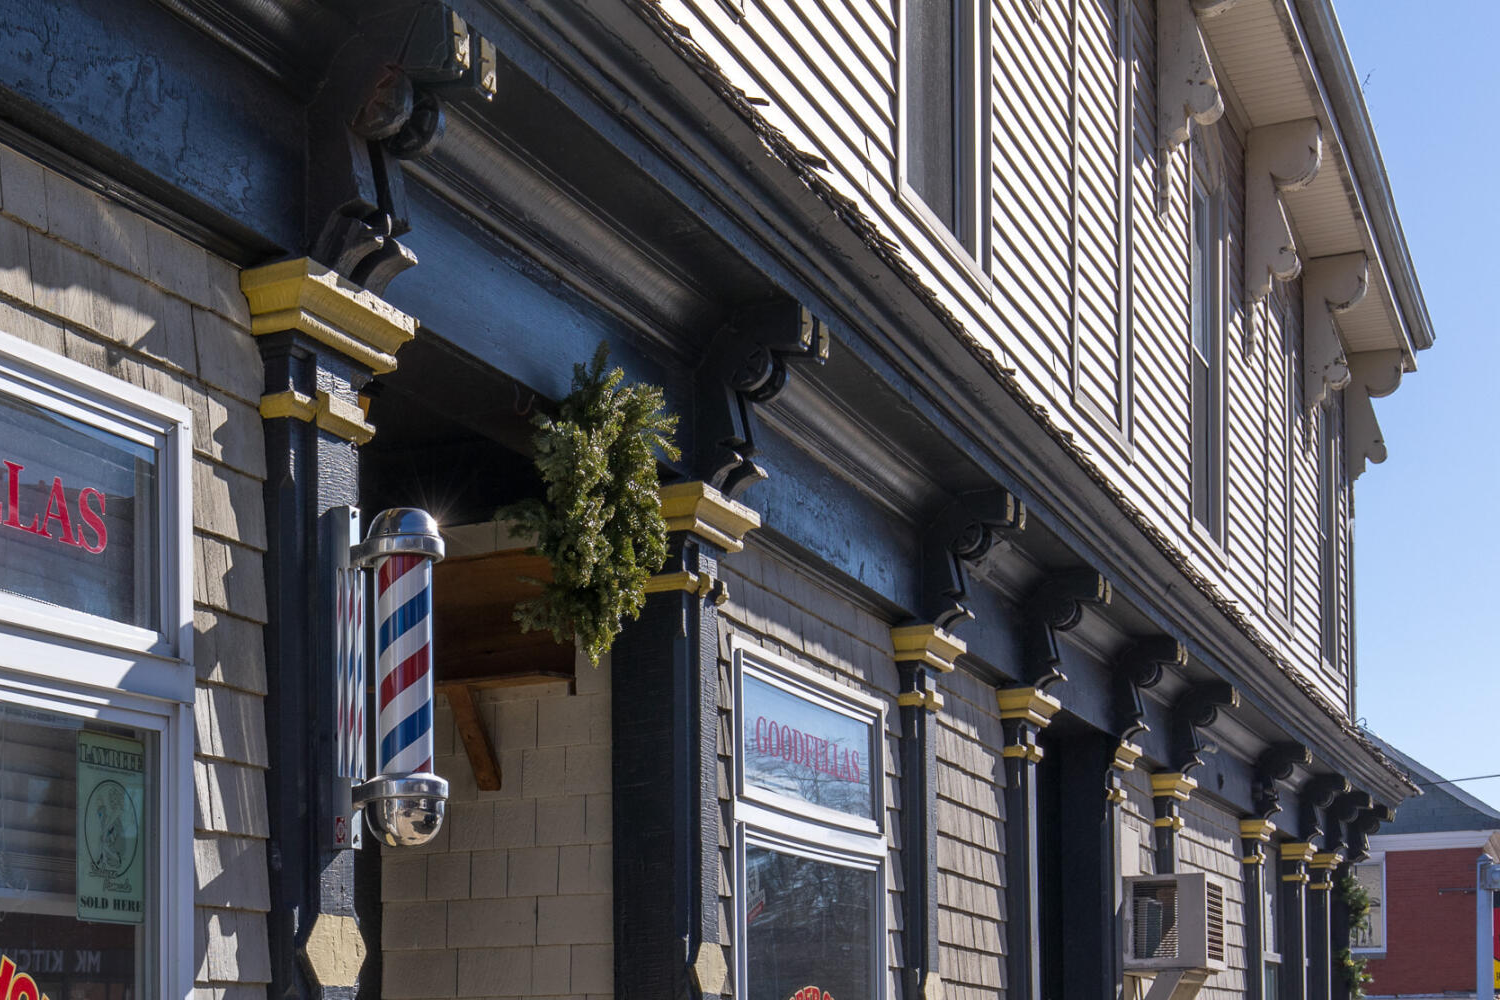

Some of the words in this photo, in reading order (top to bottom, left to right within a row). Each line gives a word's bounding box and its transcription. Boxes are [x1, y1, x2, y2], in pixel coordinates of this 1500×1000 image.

[756, 716, 860, 784] GOODFELLAS
[80, 896, 108, 910] SOLD
[113, 898, 144, 913] HERE
